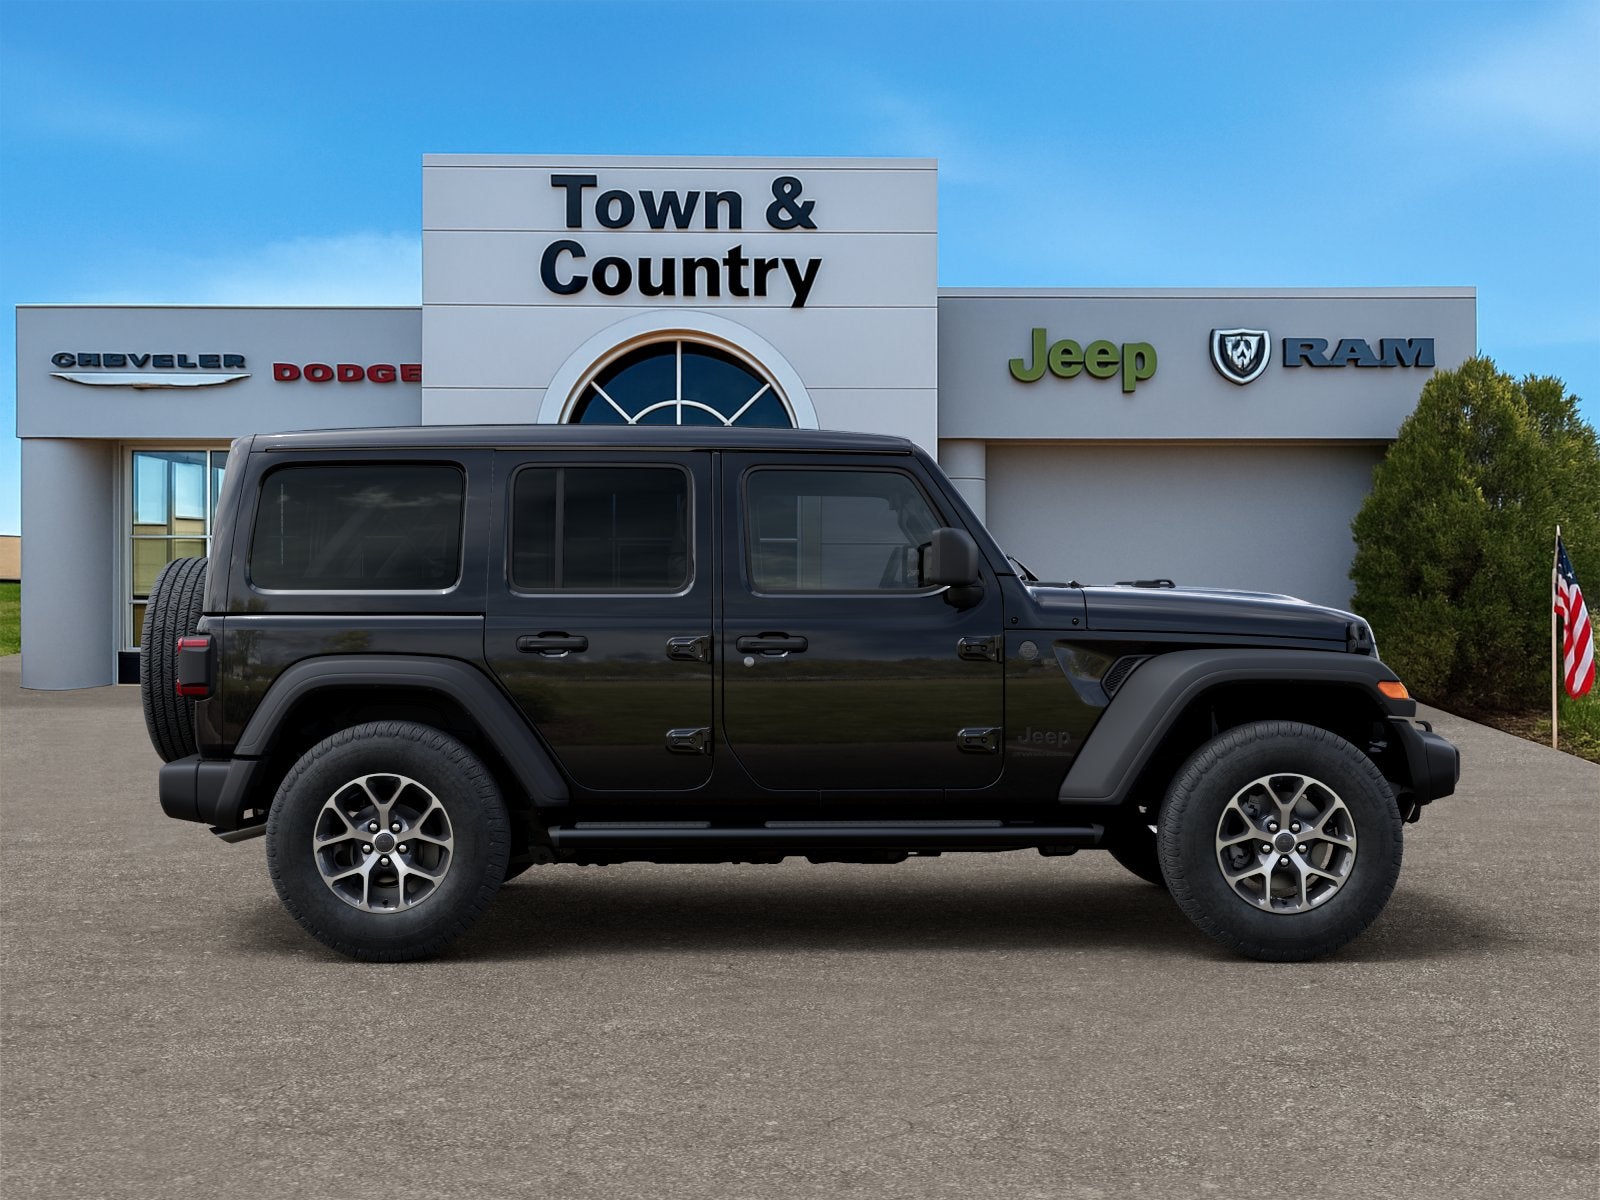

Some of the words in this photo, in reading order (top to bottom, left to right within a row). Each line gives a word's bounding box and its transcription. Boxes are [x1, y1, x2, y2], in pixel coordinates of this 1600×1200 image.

[550, 174, 742, 229] Town
[765, 176, 818, 230] &
[540, 239, 823, 308] Country
[273, 363, 422, 383] DODGE
[1009, 328, 1158, 392] Jeep
[1283, 338, 1436, 367] RAM
[1018, 726, 1071, 748] Jeep
